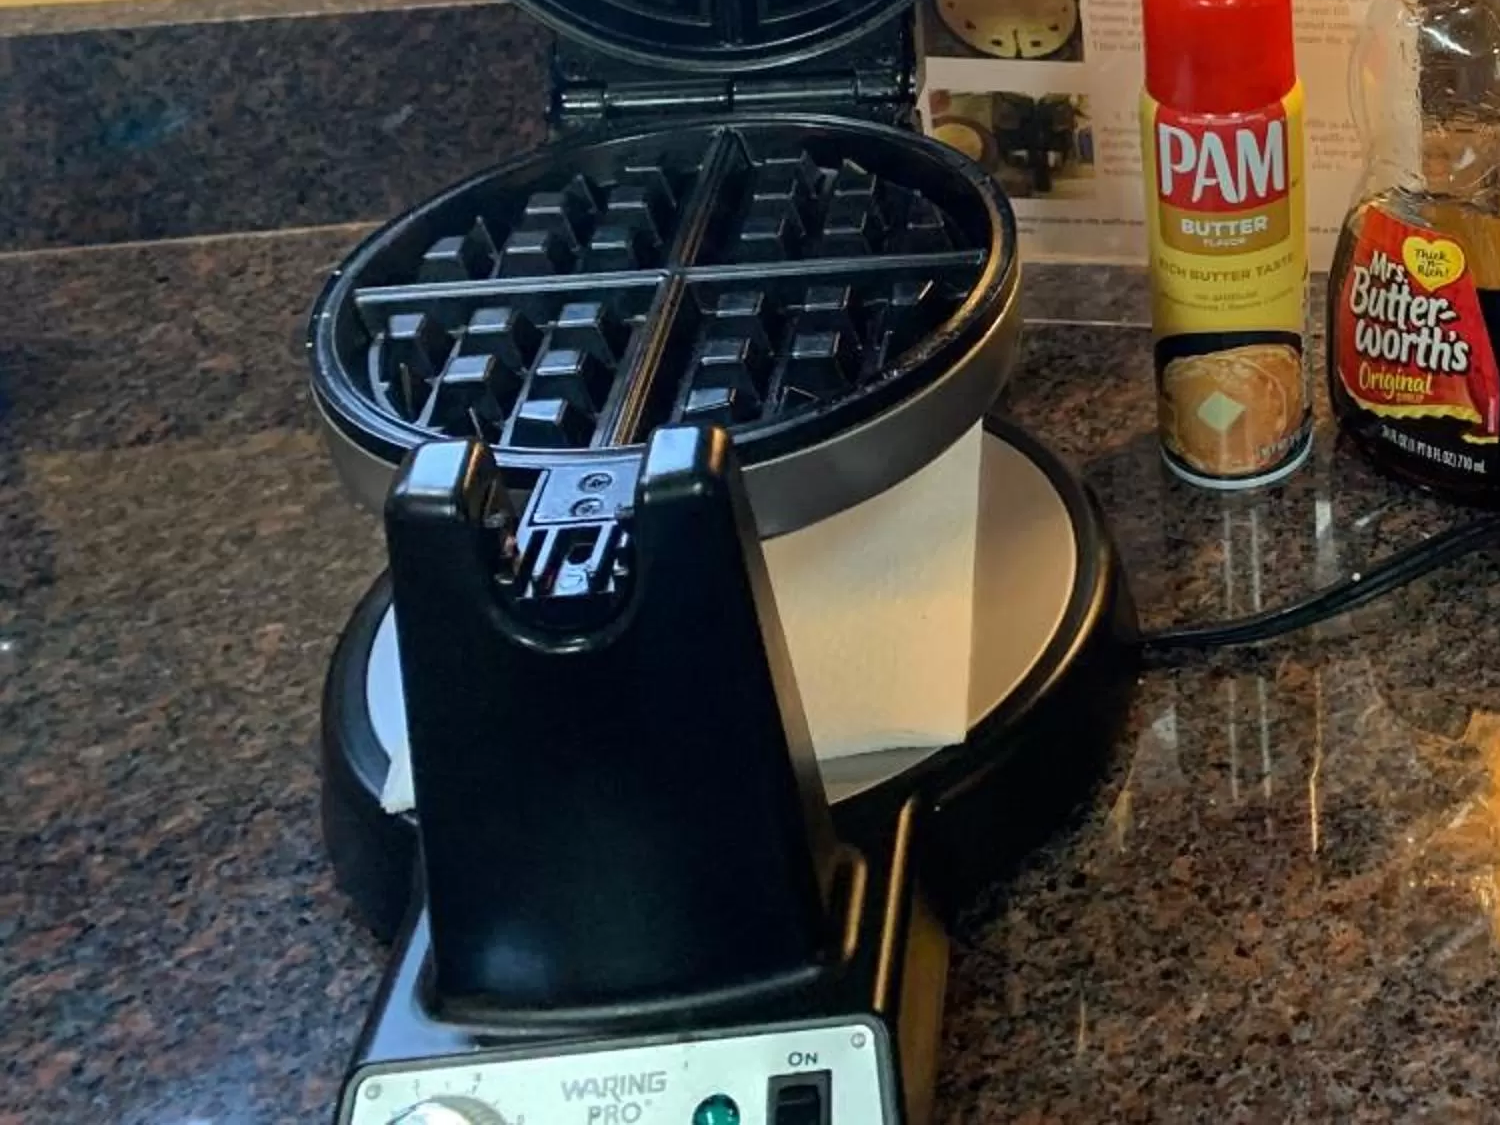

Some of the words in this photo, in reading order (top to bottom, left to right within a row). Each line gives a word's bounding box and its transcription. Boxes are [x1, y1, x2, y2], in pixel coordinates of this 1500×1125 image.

[1158, 120, 1285, 204] PAM
[1180, 214, 1269, 236] BUTTER
[1203, 236, 1247, 248] FLAVOR
[1369, 250, 1409, 284] Mrs.
[1414, 247, 1449, 263] Thick
[1190, 269, 1251, 283] BUTTER
[1417, 264, 1450, 278] Rich!
[1350, 265, 1458, 330] Butter-
[1355, 318, 1470, 372] worth's
[1359, 361, 1434, 400] Original
[787, 1050, 819, 1068] ON
[560, 1070, 668, 1103] WARING
[586, 1101, 643, 1125] PRO
